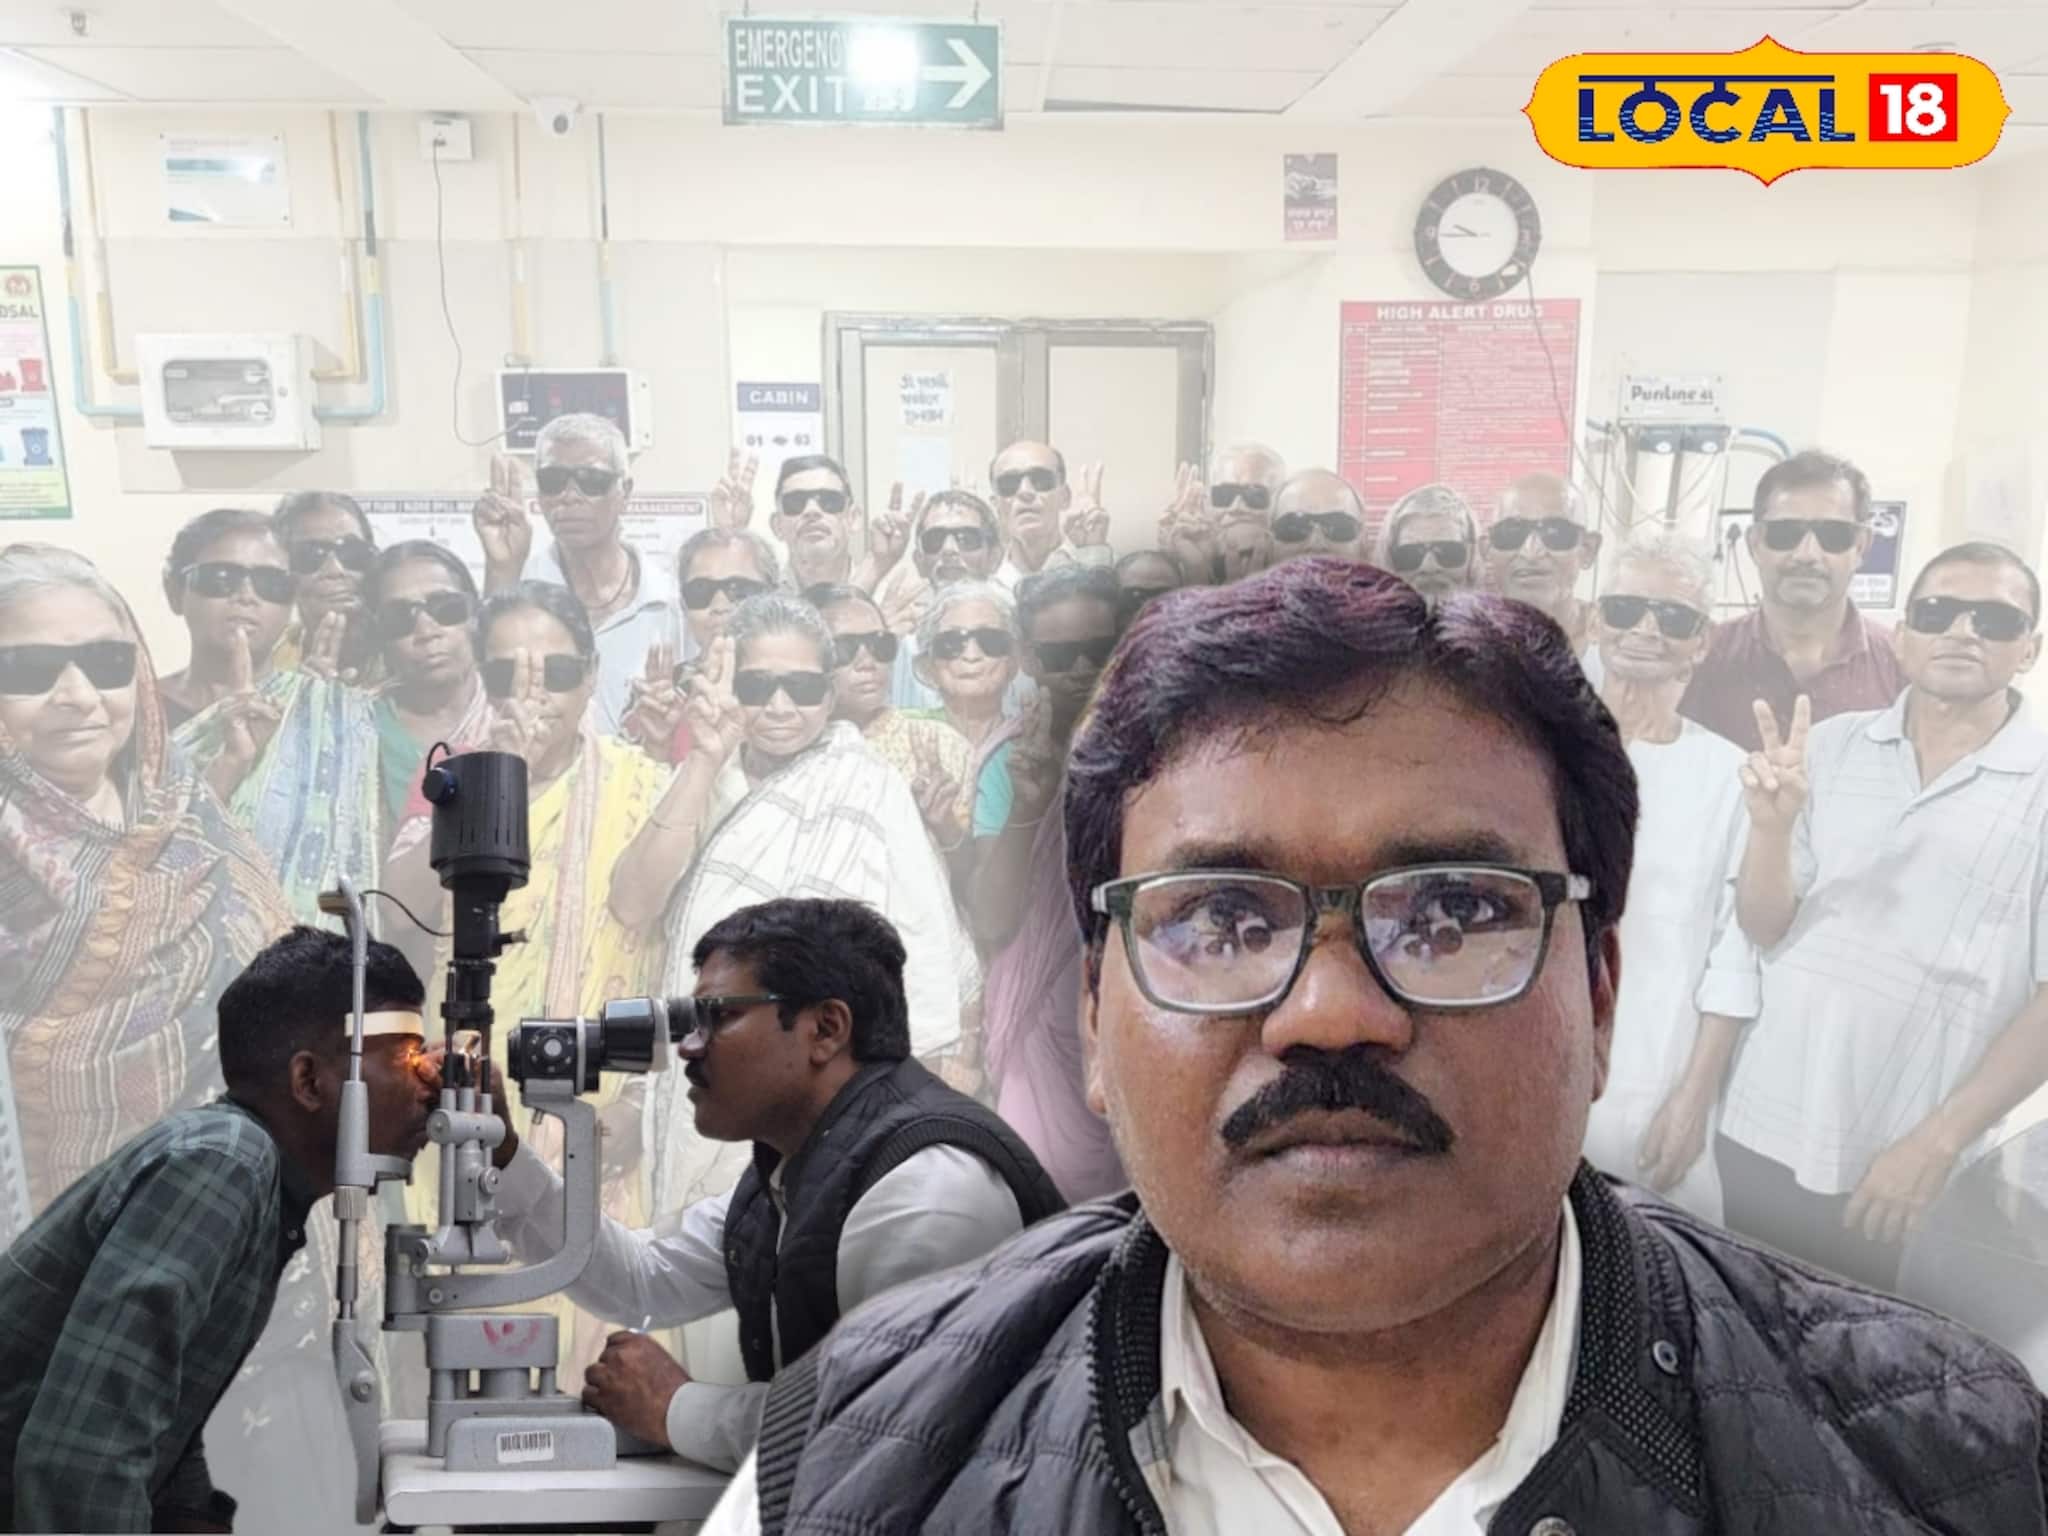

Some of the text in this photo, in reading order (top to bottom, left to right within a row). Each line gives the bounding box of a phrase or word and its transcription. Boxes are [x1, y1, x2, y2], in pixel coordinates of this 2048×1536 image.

[736, 74, 849, 113] EXIT
[1376, 305, 1423, 321] HIGH
[1428, 304, 1487, 320] ALERT
[749, 389, 809, 406] CABIN
